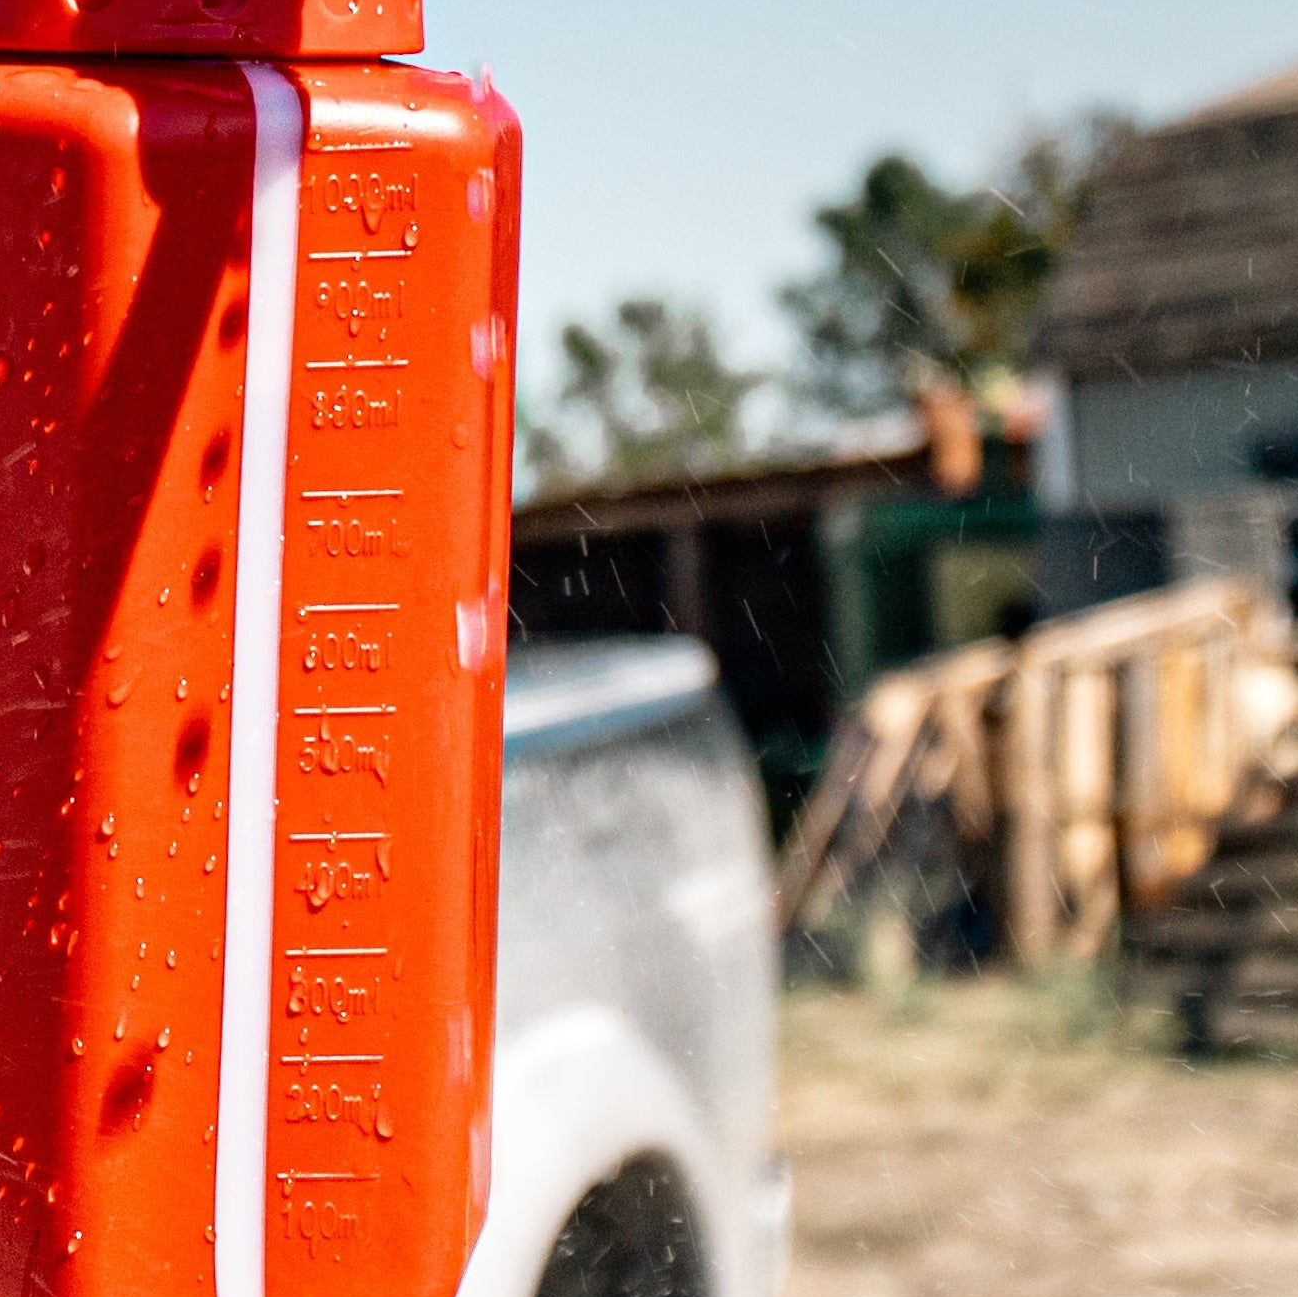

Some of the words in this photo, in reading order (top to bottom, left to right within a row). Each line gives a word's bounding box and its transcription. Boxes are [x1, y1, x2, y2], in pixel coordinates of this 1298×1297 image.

[306, 172, 419, 214] 1000ml
[316, 280, 405, 319] 900ml
[311, 389, 402, 429] 800ml
[307, 518, 398, 558] 700ml
[303, 632, 393, 670] 600ml
[299, 734, 390, 772] 500ml
